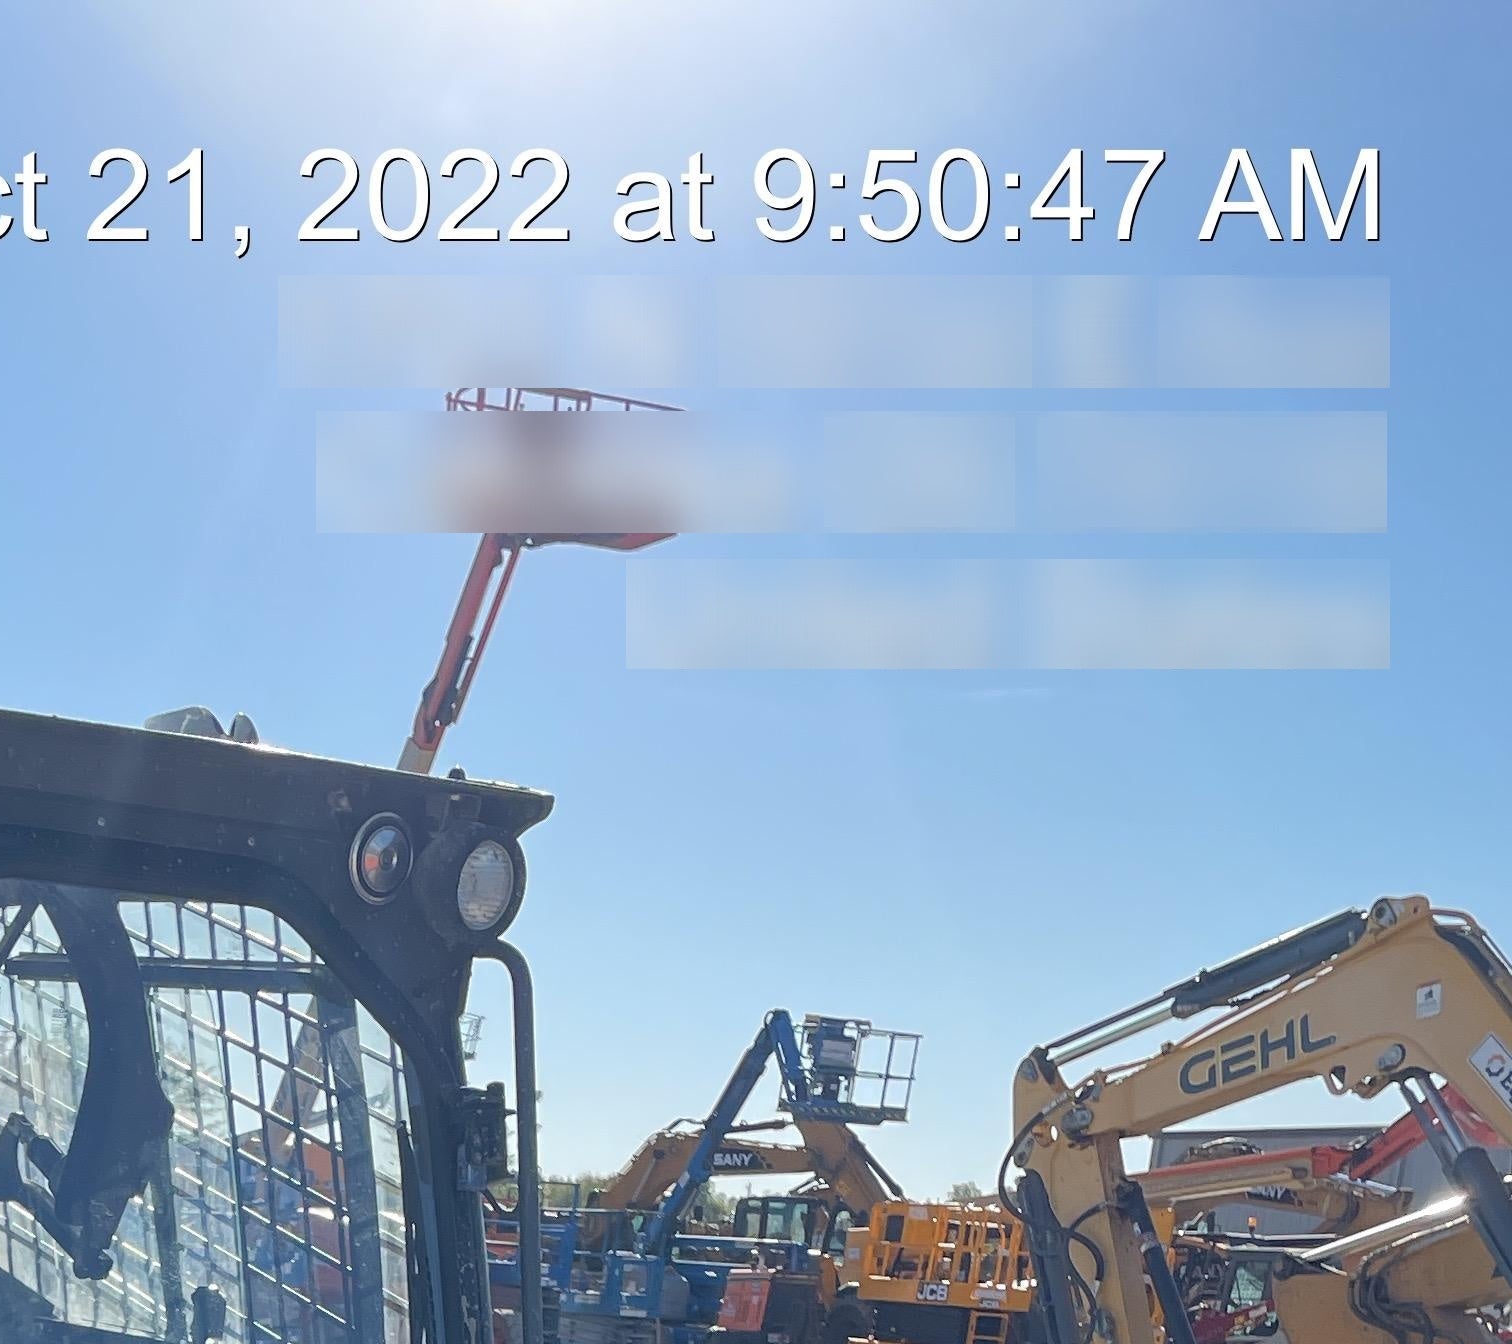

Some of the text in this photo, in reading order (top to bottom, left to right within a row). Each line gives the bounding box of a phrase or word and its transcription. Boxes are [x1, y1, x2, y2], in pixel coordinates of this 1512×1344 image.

[1179, 1013, 1337, 1094] GEHL
[712, 1152, 753, 1167] SANY
[916, 1283, 949, 1302] JCB
